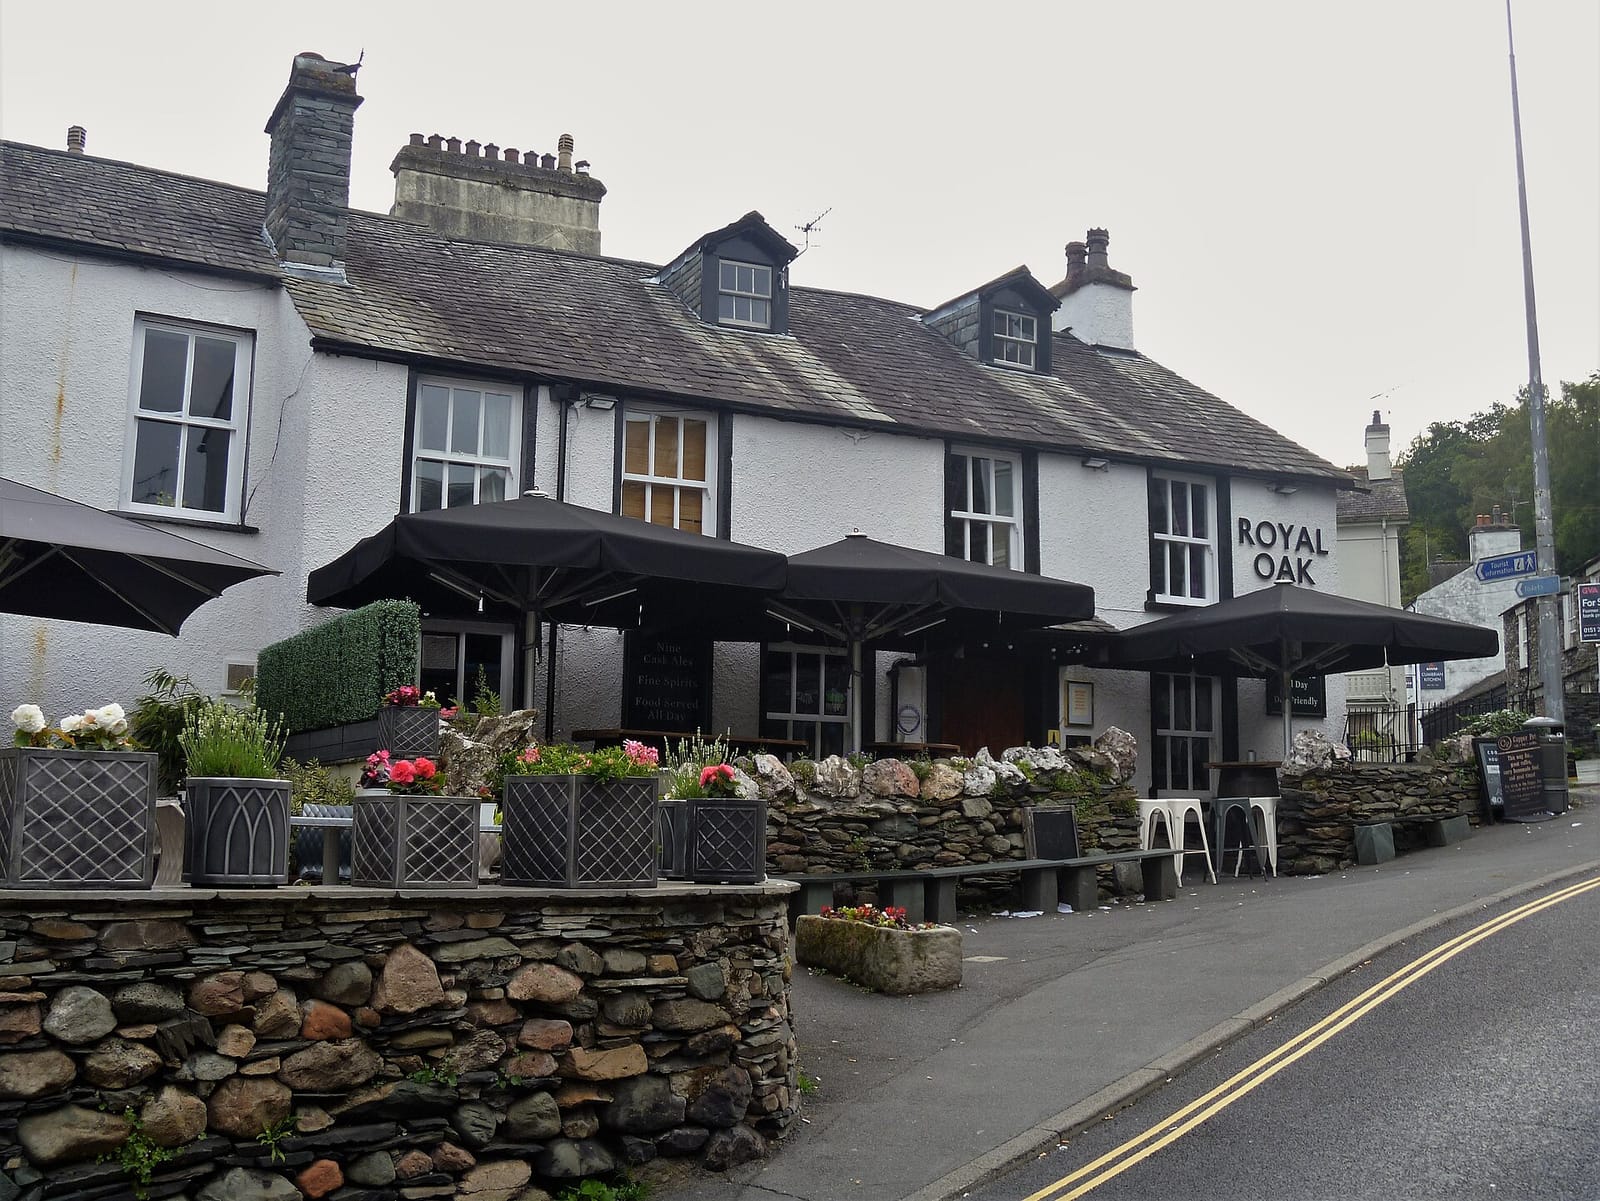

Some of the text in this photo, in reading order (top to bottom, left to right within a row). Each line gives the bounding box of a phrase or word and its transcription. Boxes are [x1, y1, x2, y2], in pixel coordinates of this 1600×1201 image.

[1238, 517, 1329, 555] ROYAL
[1254, 553, 1316, 585] OAK
[1491, 561, 1509, 569] Tourist
[1582, 587, 1598, 595] GVA
[1583, 598, 1595, 607] For
[1295, 680, 1309, 691] Day
